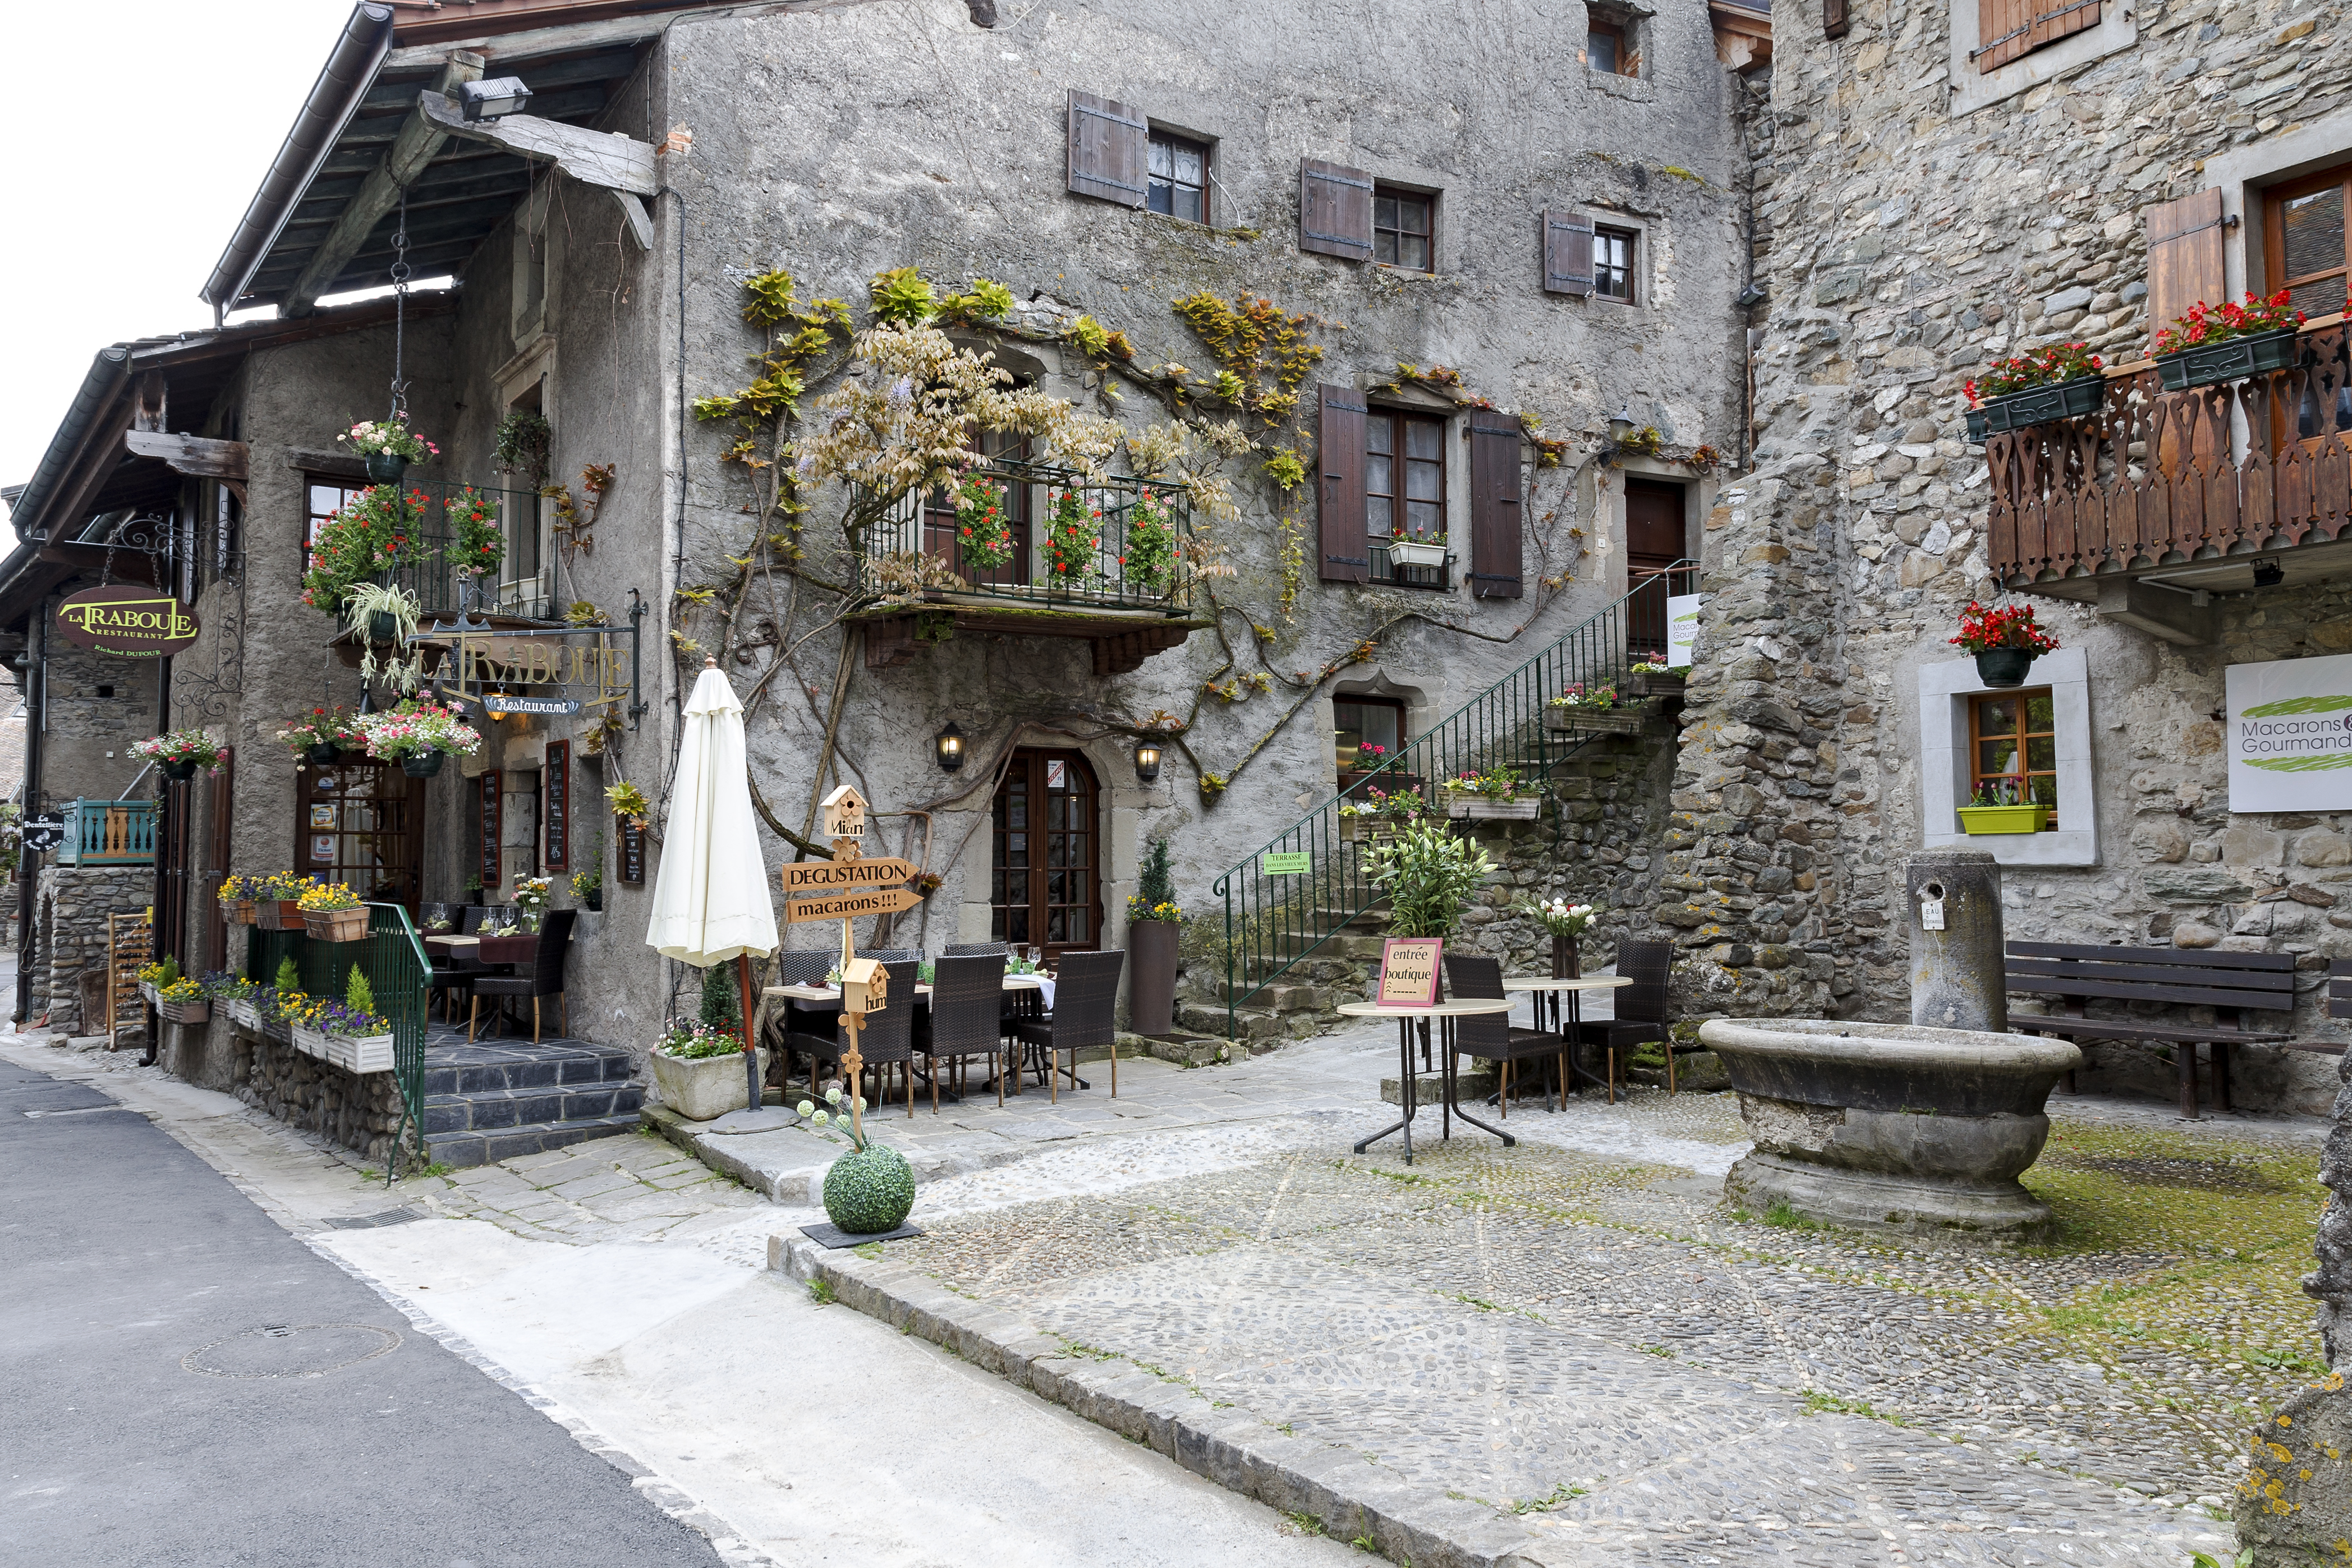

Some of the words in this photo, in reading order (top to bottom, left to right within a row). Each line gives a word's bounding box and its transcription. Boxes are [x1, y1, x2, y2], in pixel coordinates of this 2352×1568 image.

[59, 598, 197, 640] TRABOULE
[68, 614, 84, 623] LA
[97, 629, 163, 640] RESTAURANT
[1673, 623, 1699, 632] Macar
[94, 645, 124, 656] Richard
[433, 632, 632, 708] TRABOULE
[497, 697, 569, 714] Restaurant
[2242, 719, 2341, 737] Macarons
[2242, 733, 2351, 753] Gourmand
[791, 865, 907, 885] DEGUSTATION
[1393, 946, 1428, 960] entrée
[1385, 966, 1431, 984] boutique
